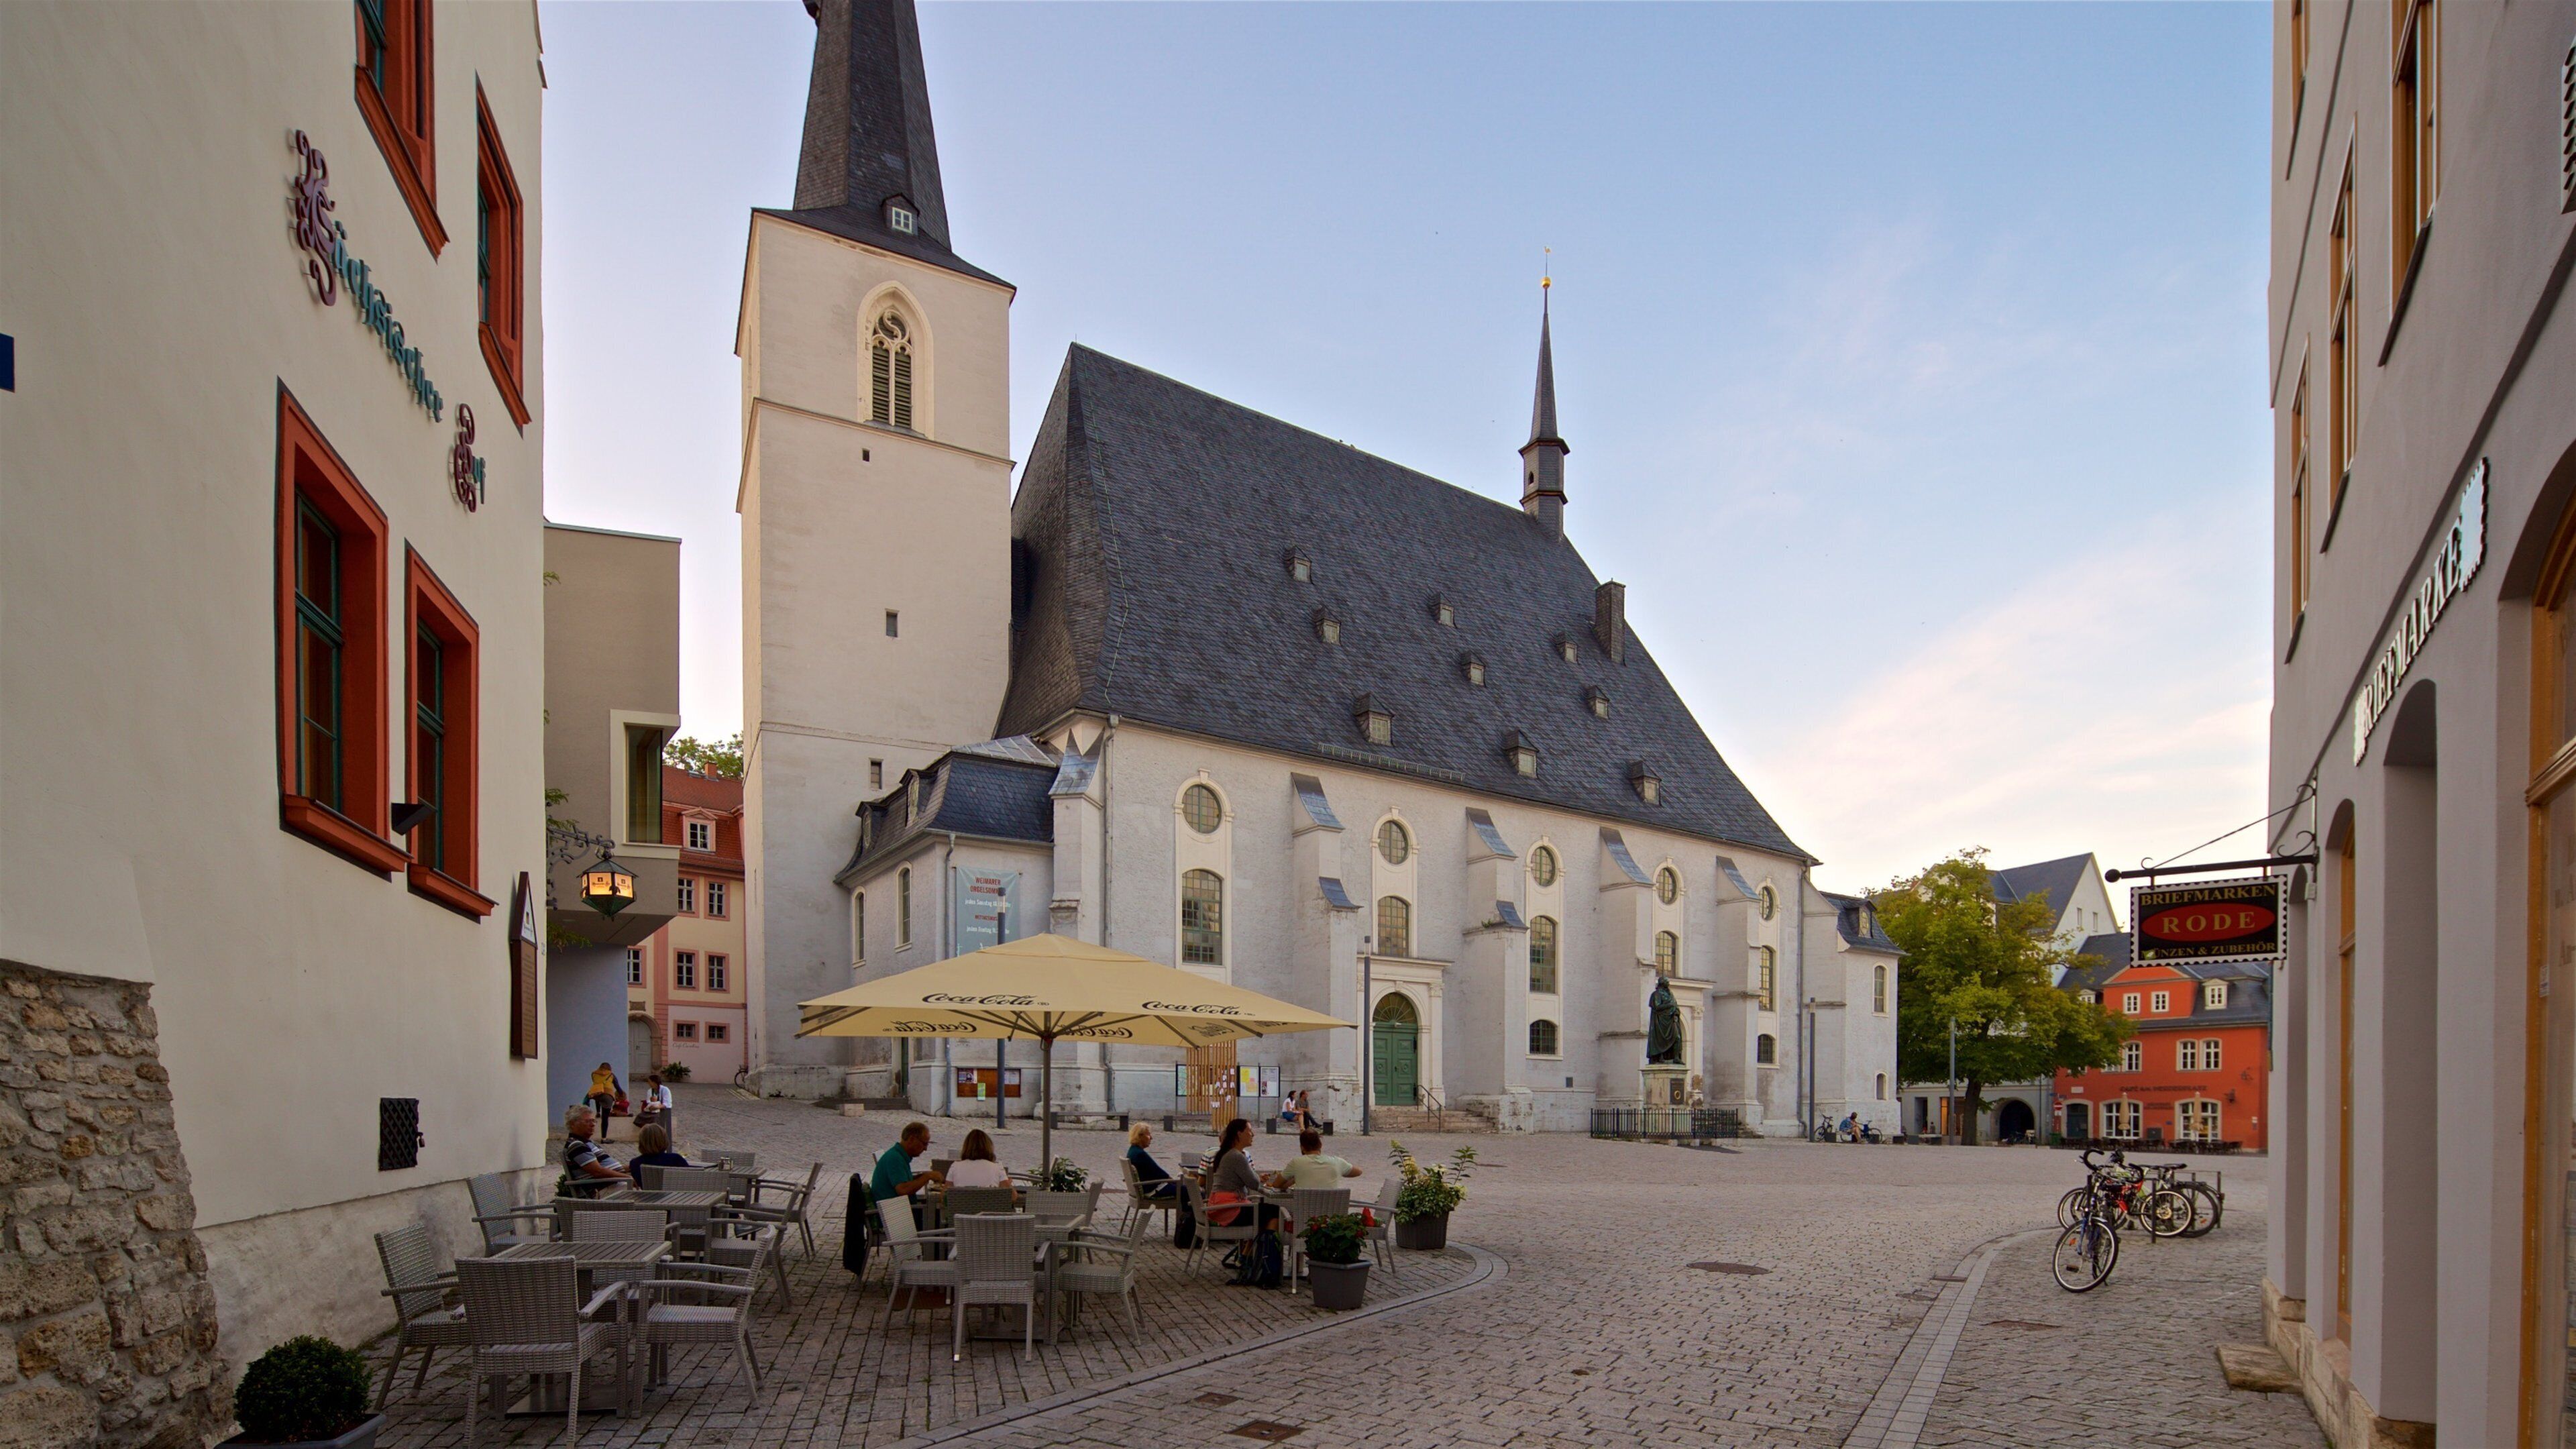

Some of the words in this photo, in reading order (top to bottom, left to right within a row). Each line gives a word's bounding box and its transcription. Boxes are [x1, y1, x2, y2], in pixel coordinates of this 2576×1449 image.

[975, 877, 1001, 885] WEIMARER
[969, 885, 998, 894] ORGELSOMM
[2141, 884, 2276, 906] BRIEFMARKEN
[2162, 912, 2255, 934] RODE
[2198, 947, 2207, 955] &
[2211, 942, 2276, 955] ZUBEHÖR
[922, 993, 1038, 1006] Coca-Cola
[1142, 1001, 1240, 1016] Coca-Cola
